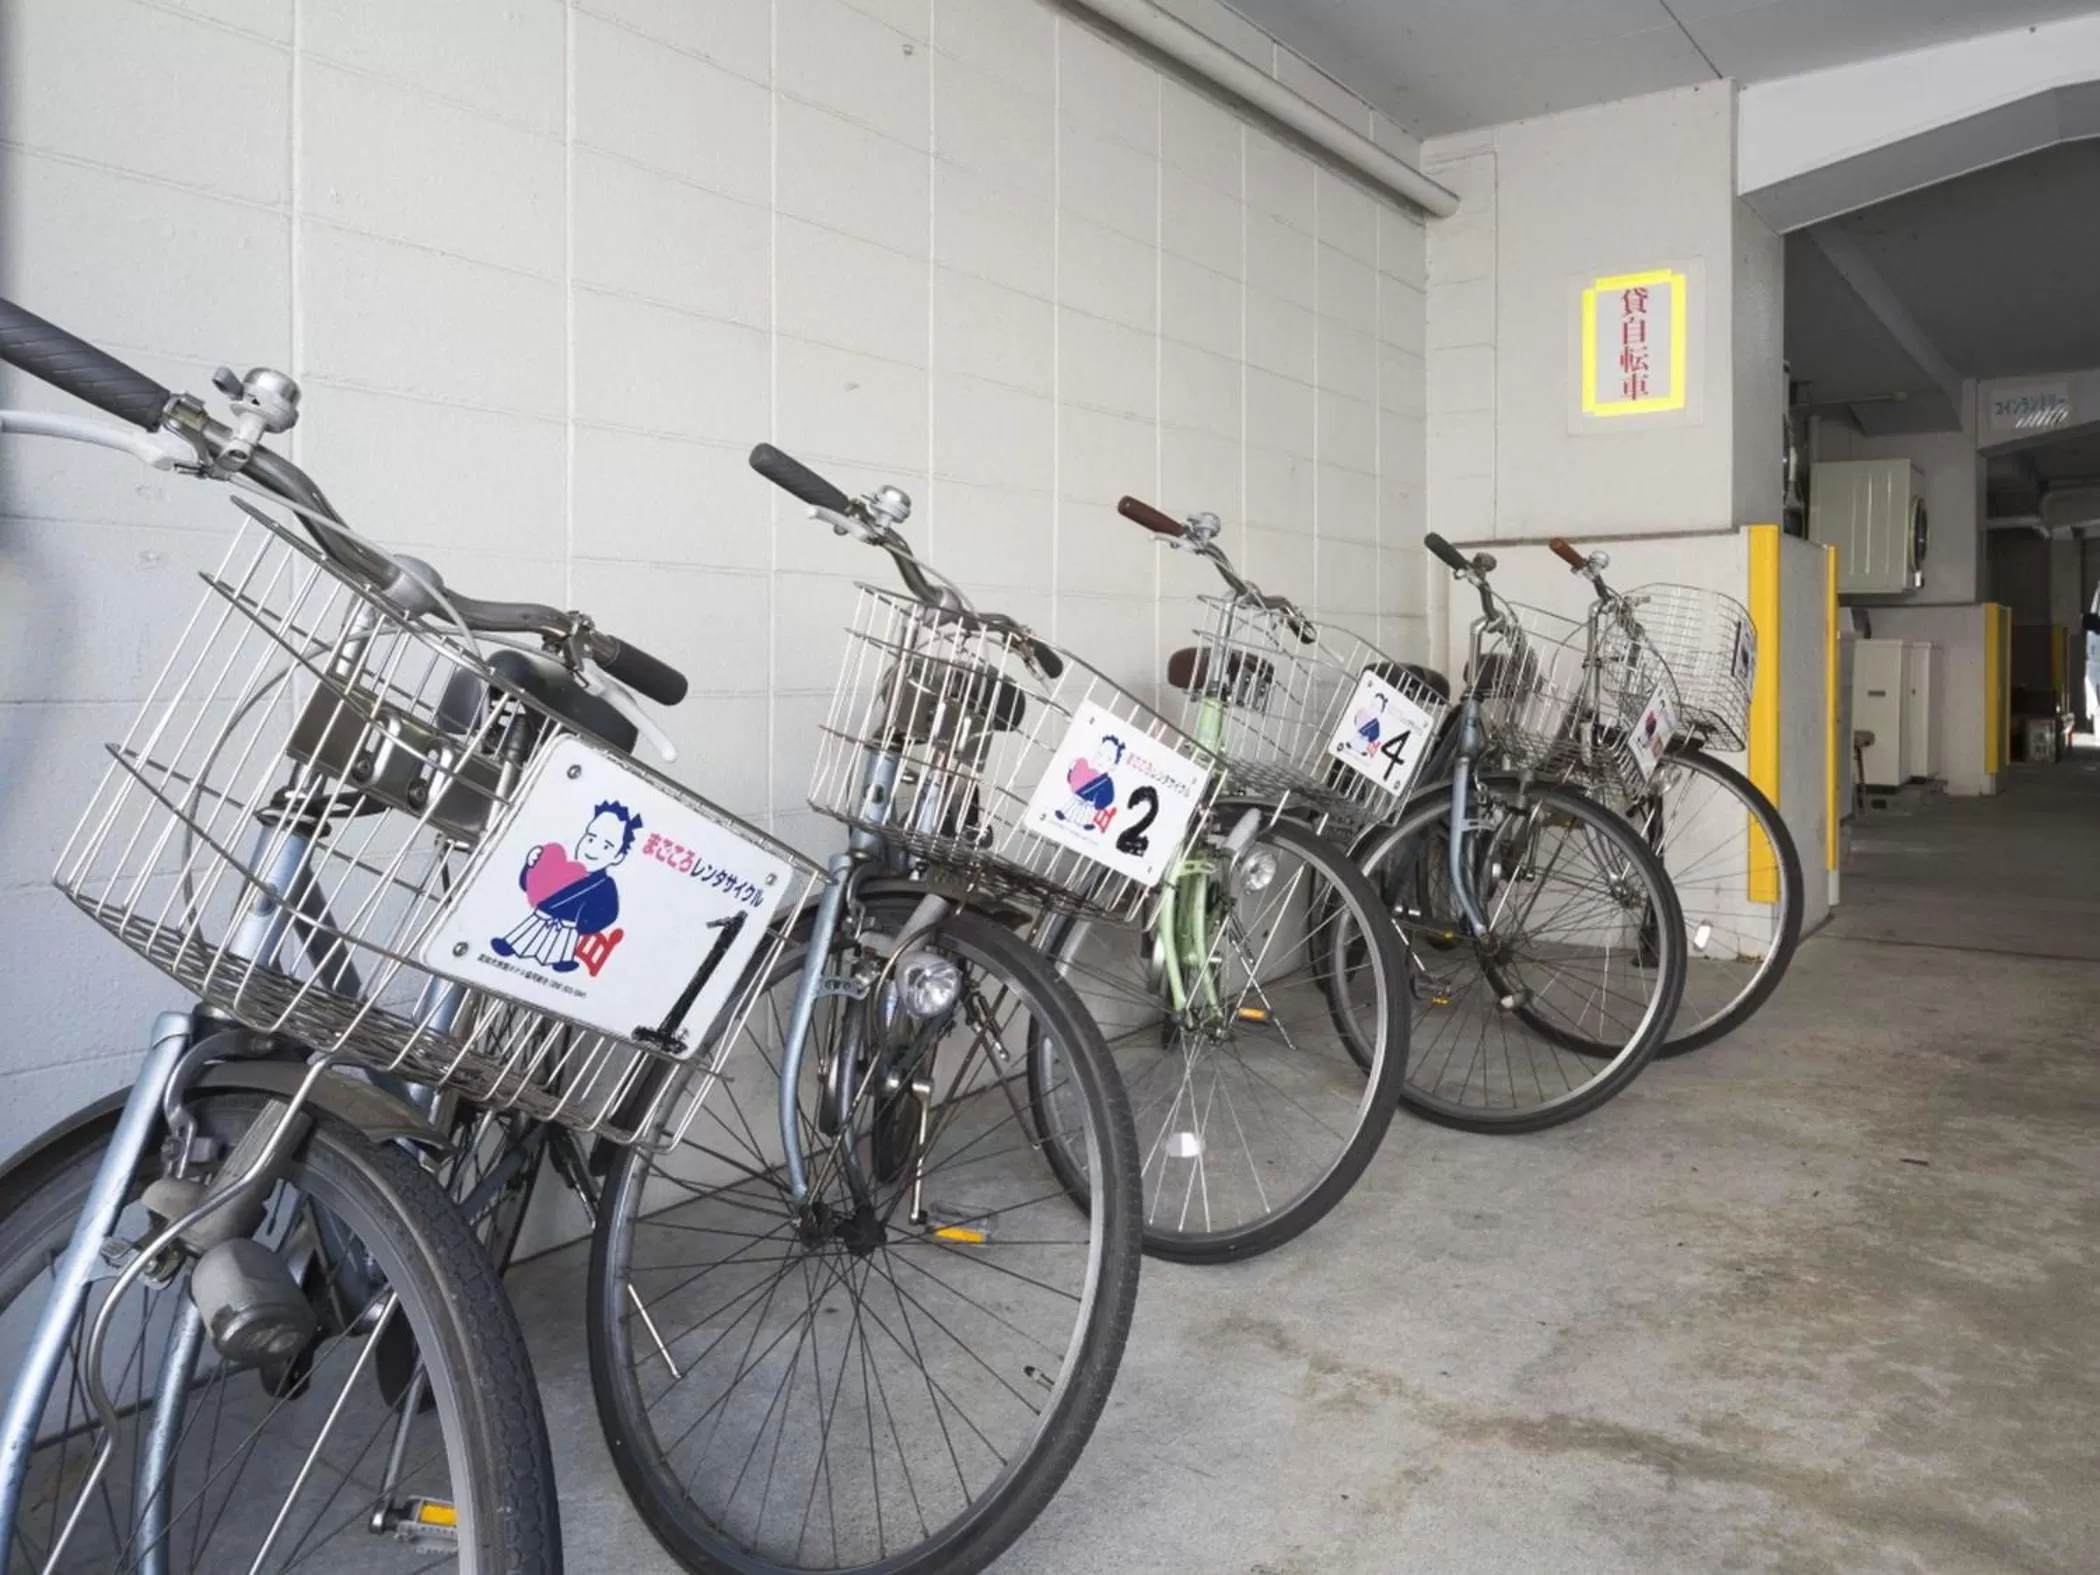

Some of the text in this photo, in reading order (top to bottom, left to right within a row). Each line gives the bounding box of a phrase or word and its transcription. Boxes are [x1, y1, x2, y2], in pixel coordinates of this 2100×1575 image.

[1619, 286, 1649, 401] 貸自転車
[1380, 730, 1412, 783] 4
[1115, 785, 1159, 857] 2
[642, 832, 765, 908] まごころレンタサイクル
[630, 909, 749, 1054] 1
